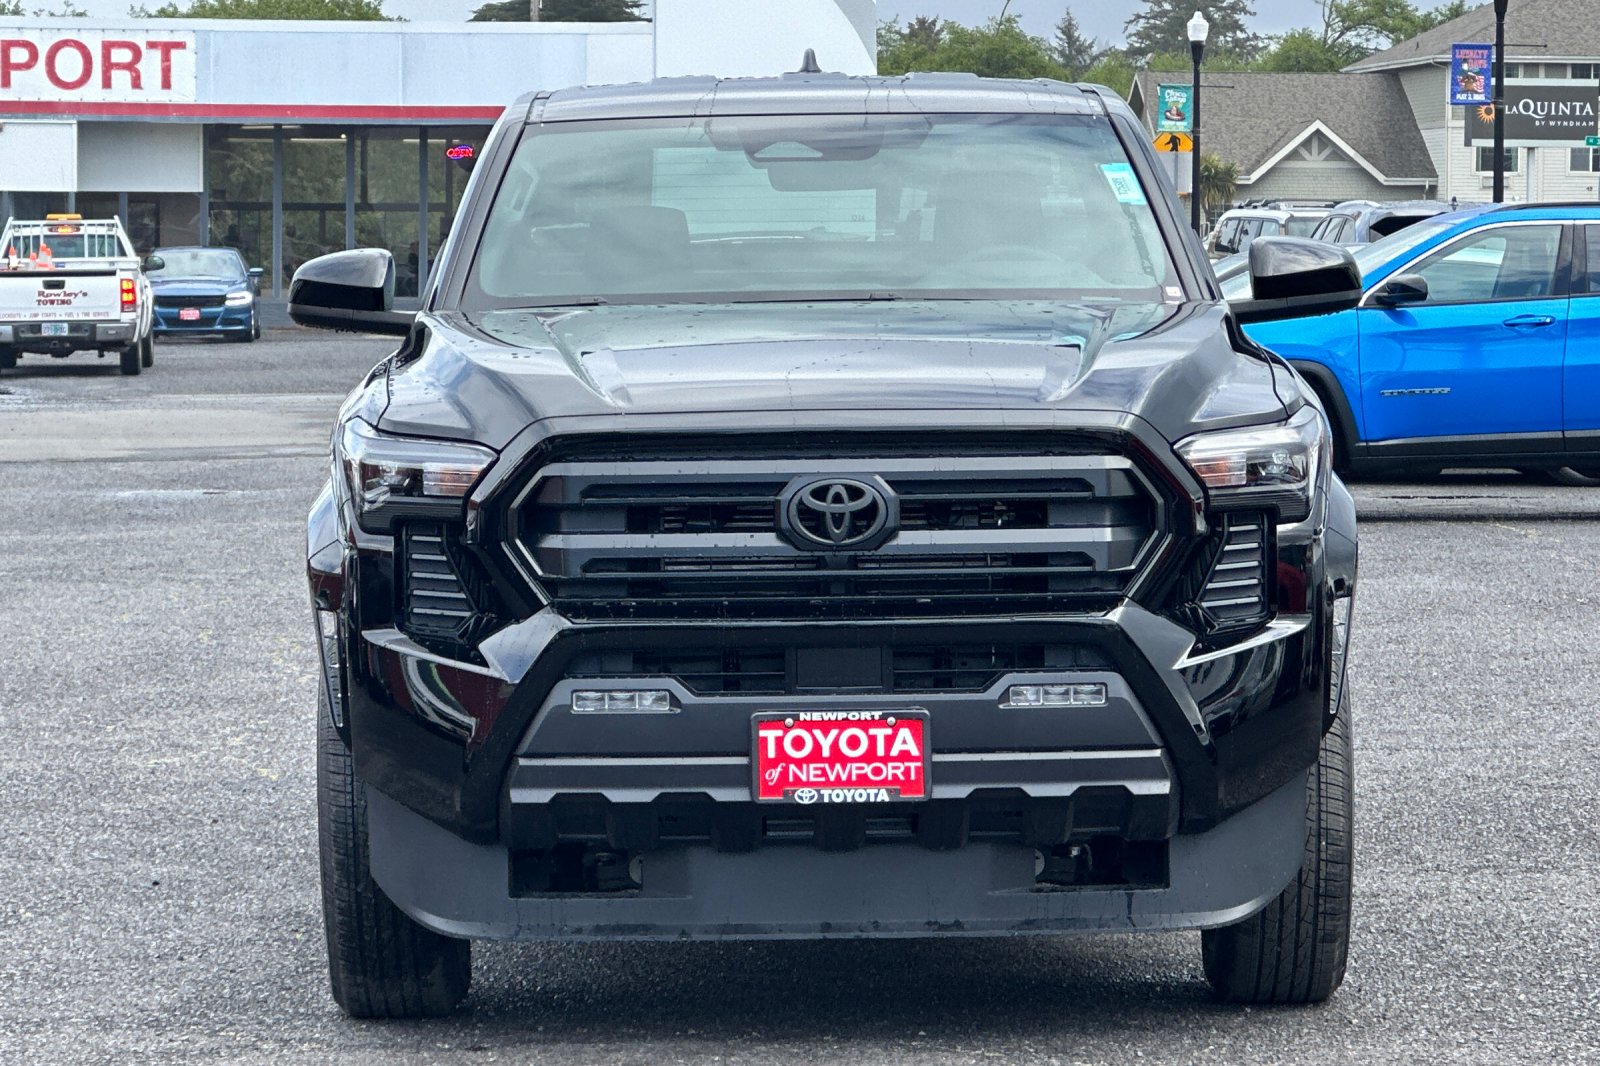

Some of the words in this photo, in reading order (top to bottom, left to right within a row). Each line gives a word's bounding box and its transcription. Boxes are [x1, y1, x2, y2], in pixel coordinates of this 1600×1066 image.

[0, 38, 187, 91] PORT
[446, 147, 474, 158] OPEN
[37, 290, 88, 299] Rowley's
[799, 711, 883, 721] NEWPORT
[758, 727, 920, 759] TOYOTA
[765, 762, 786, 786] of
[788, 761, 922, 783] NEWPORT
[819, 788, 890, 803] TOYOTA
